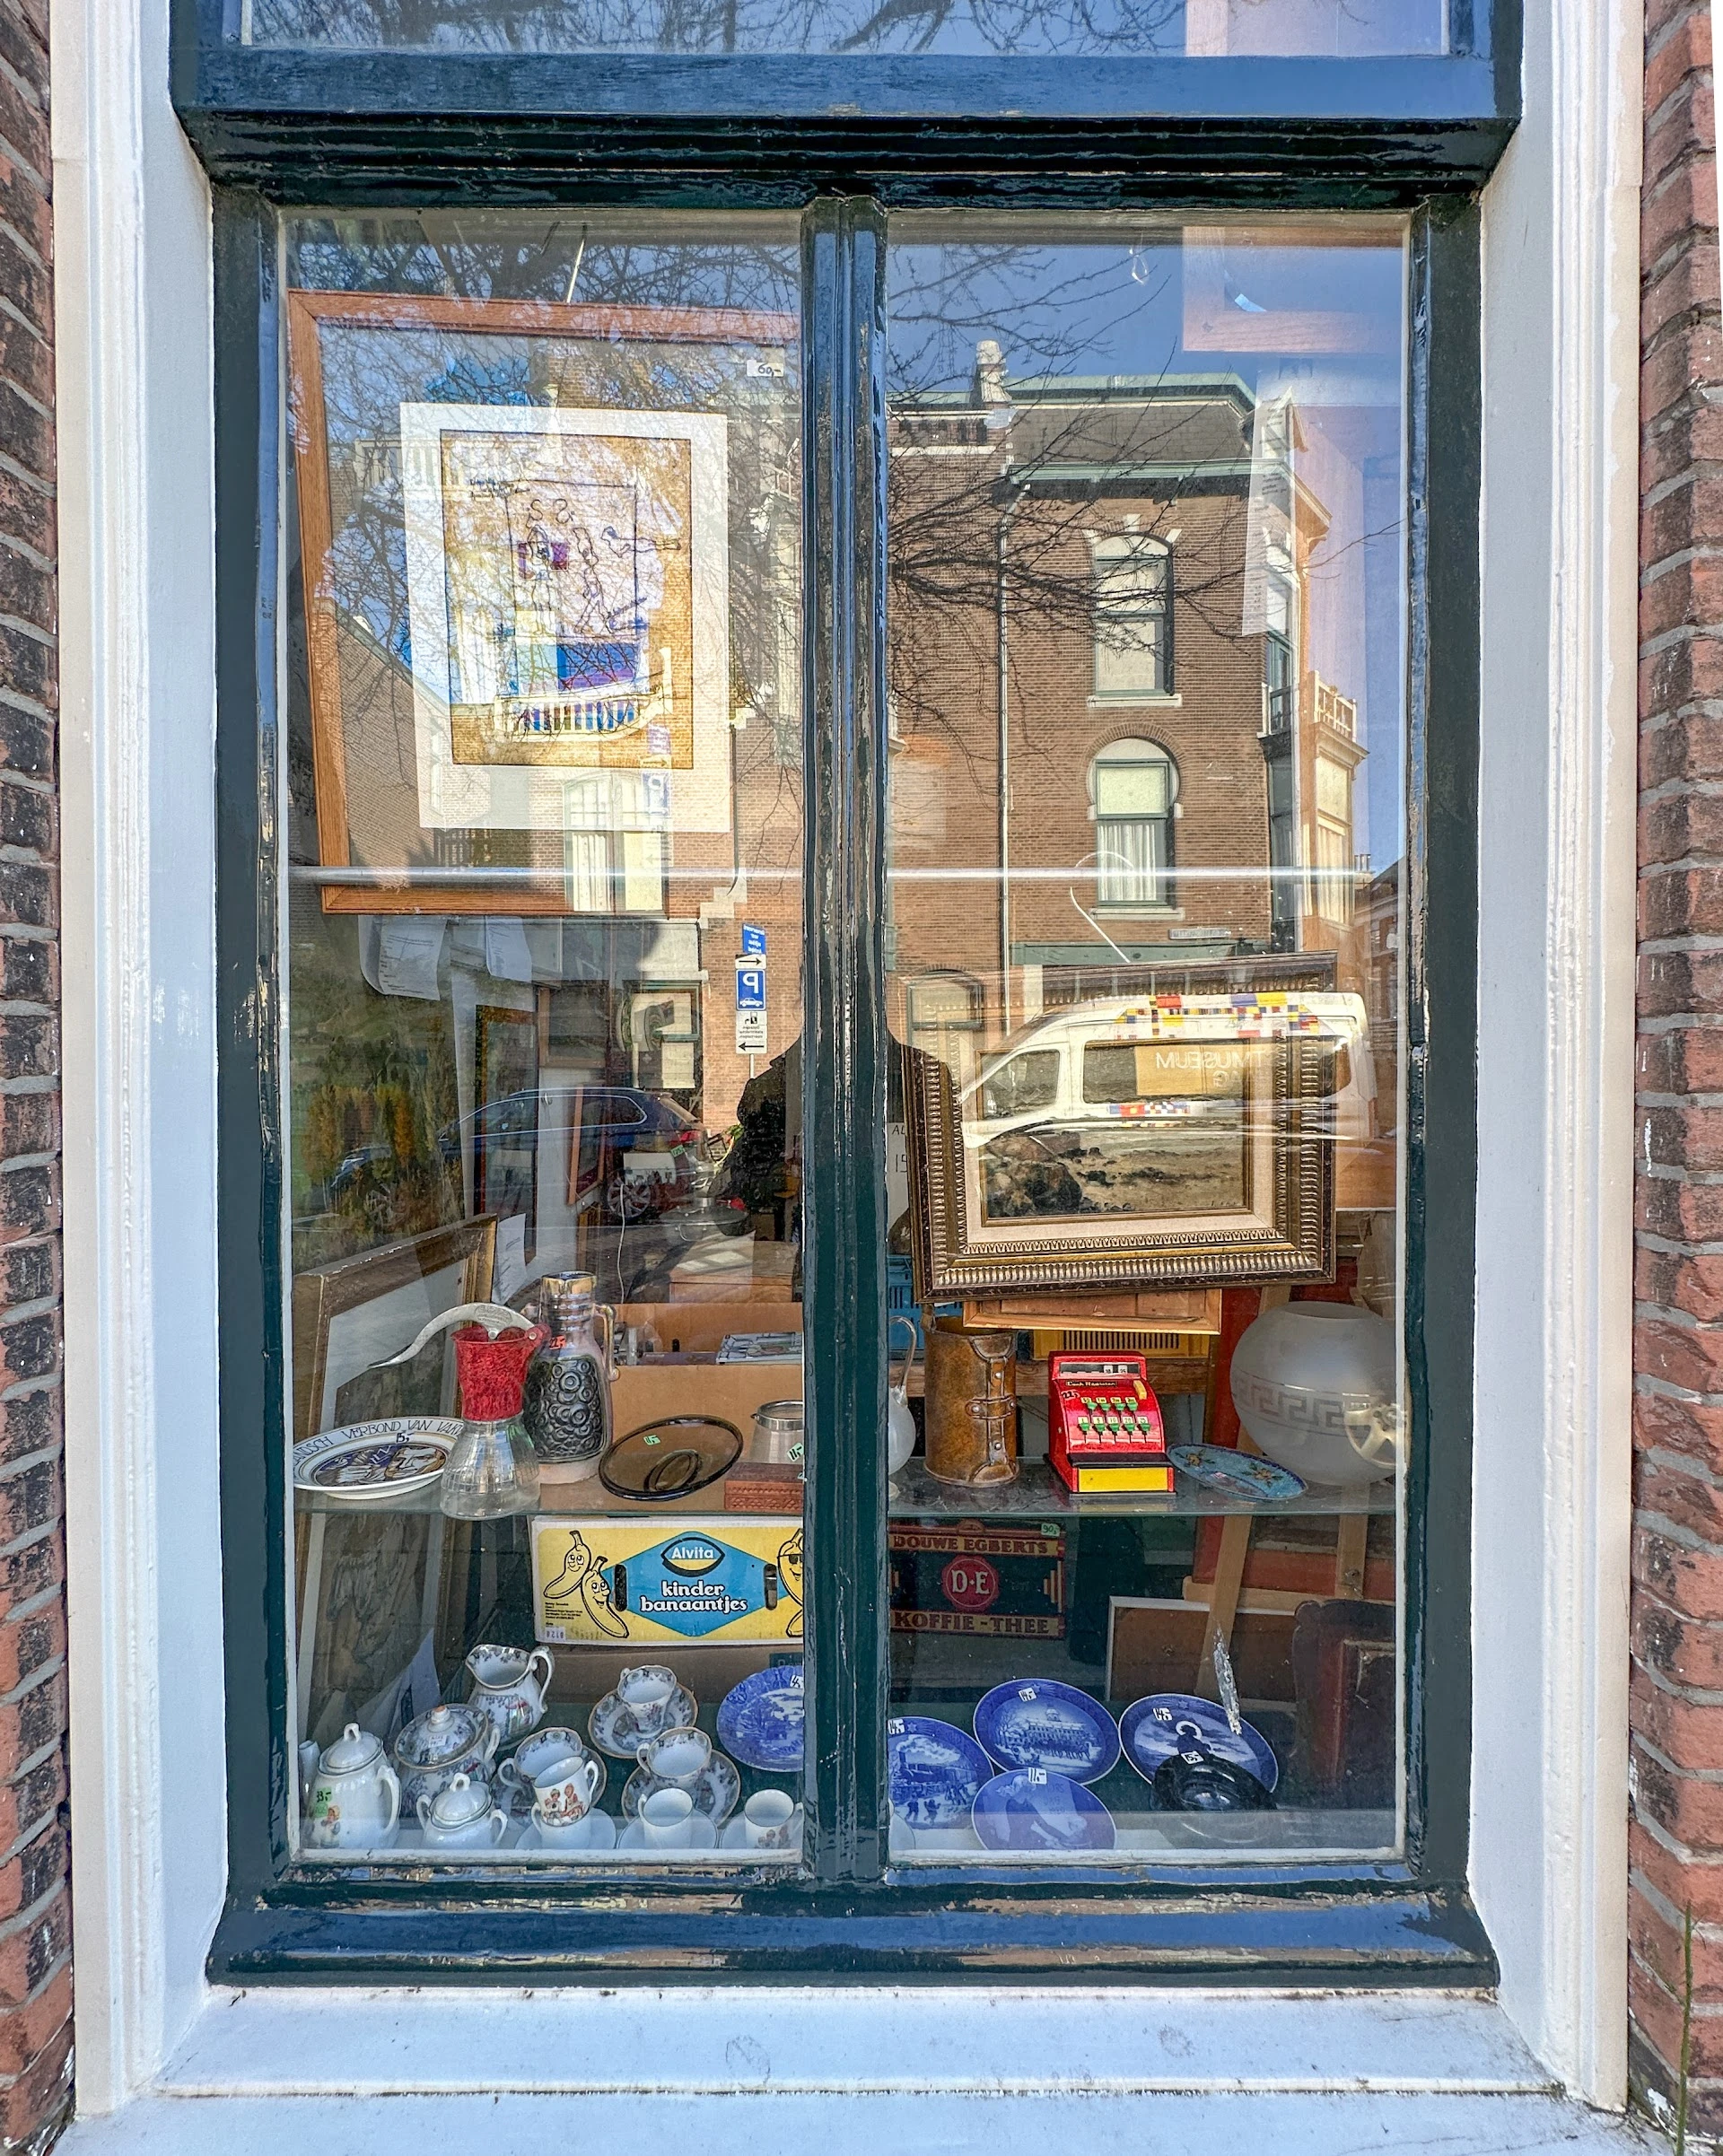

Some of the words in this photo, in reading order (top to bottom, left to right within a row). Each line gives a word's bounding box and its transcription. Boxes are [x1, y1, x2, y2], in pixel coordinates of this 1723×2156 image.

[341, 1420, 402, 1439] VERBOND
[407, 1419, 434, 1431] VAN
[671, 1547, 714, 1559] Alvita
[893, 1536, 958, 1550] DOUWE
[964, 1537, 1048, 1554] EGBERTS
[661, 1580, 725, 1597] kinder
[640, 1595, 748, 1615] banaantjes
[894, 1613, 975, 1630] KOFFIE
